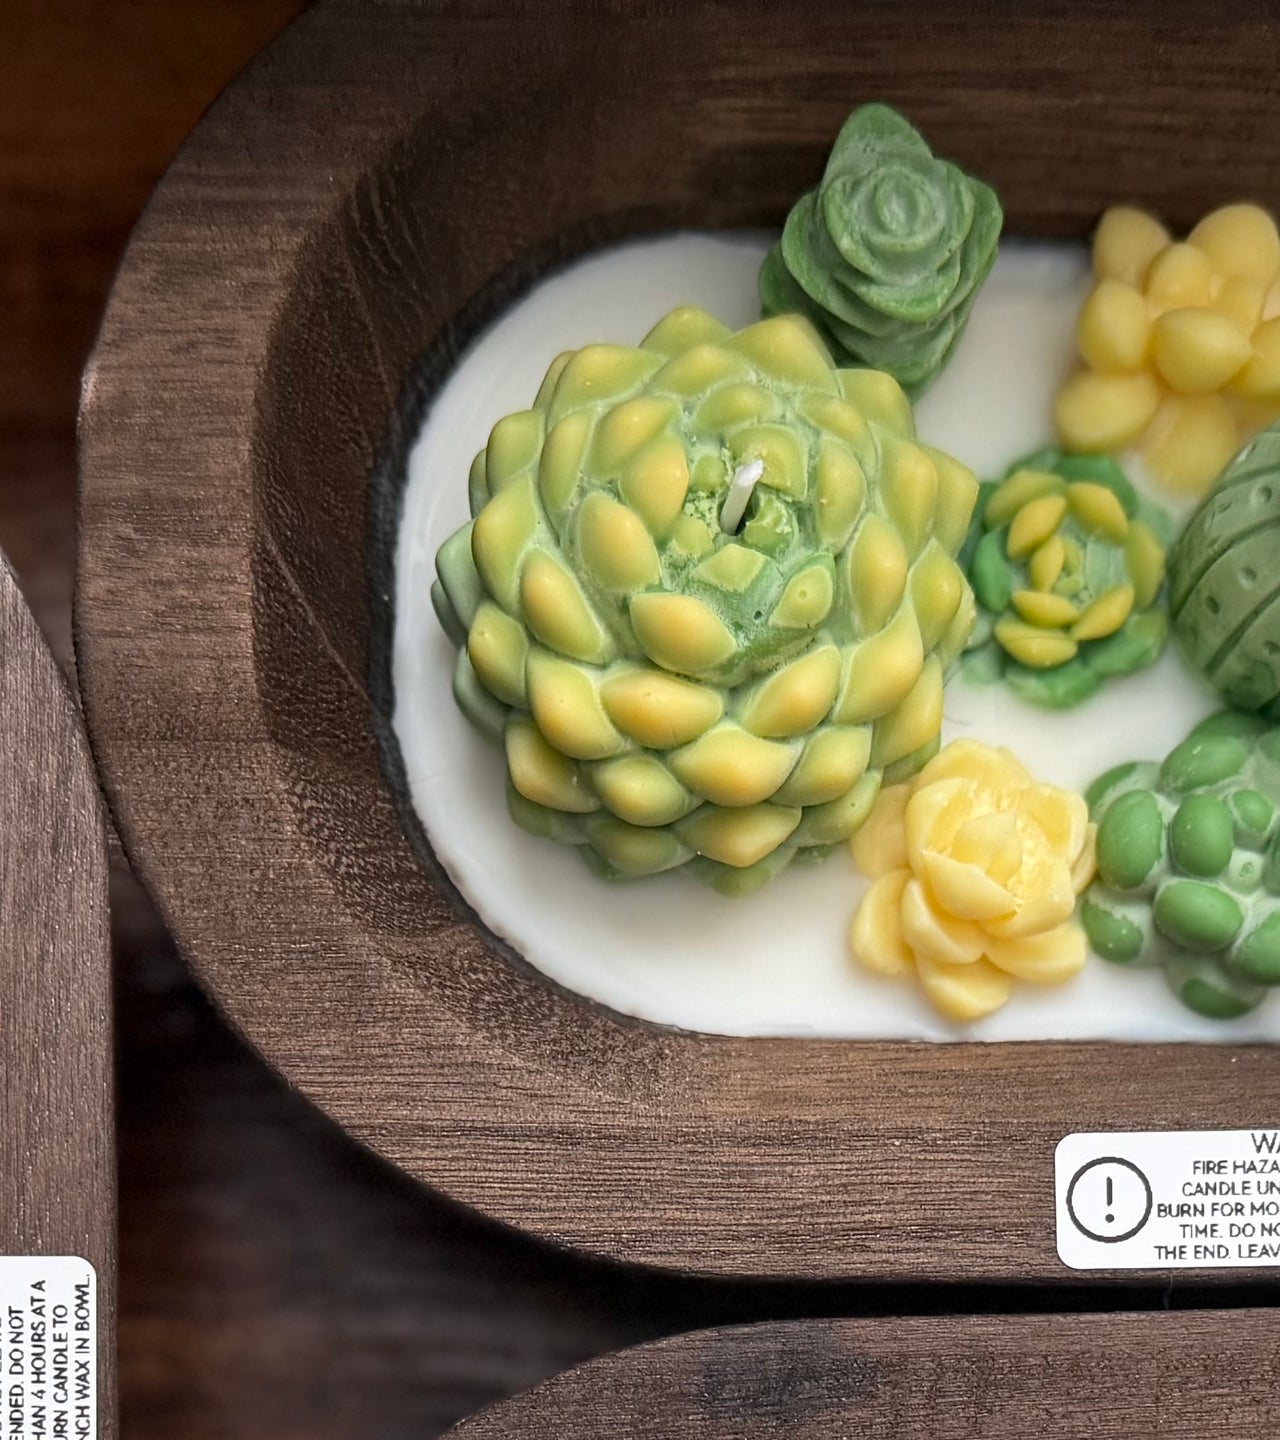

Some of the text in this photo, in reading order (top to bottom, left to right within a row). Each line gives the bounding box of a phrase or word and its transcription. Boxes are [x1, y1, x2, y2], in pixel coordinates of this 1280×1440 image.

[1192, 1158, 1228, 1175] FIRE
[1182, 1180, 1253, 1197] CANDLE
[1157, 1202, 1205, 1219] BURN
[1211, 1202, 1245, 1218] FOR
[1179, 1223, 1224, 1239] TIME.
[1228, 1222, 1255, 1239] DO
[1153, 1244, 1190, 1260] THE
[1193, 1243, 1232, 1260] END.
[30, 1280, 47, 1292] A
[30, 1296, 47, 1318] AT
[75, 1273, 91, 1331] BOWL.
[8, 1306, 25, 1344] NOT
[52, 1304, 69, 1330] TO
[30, 1321, 46, 1384] HOURS
[75, 1337, 91, 1355] IN
[8, 1348, 25, 1375] DO
[52, 1331, 69, 1403] CANDLE
[74, 1360, 91, 1401] WAX
[30, 1388, 46, 1400] 4
